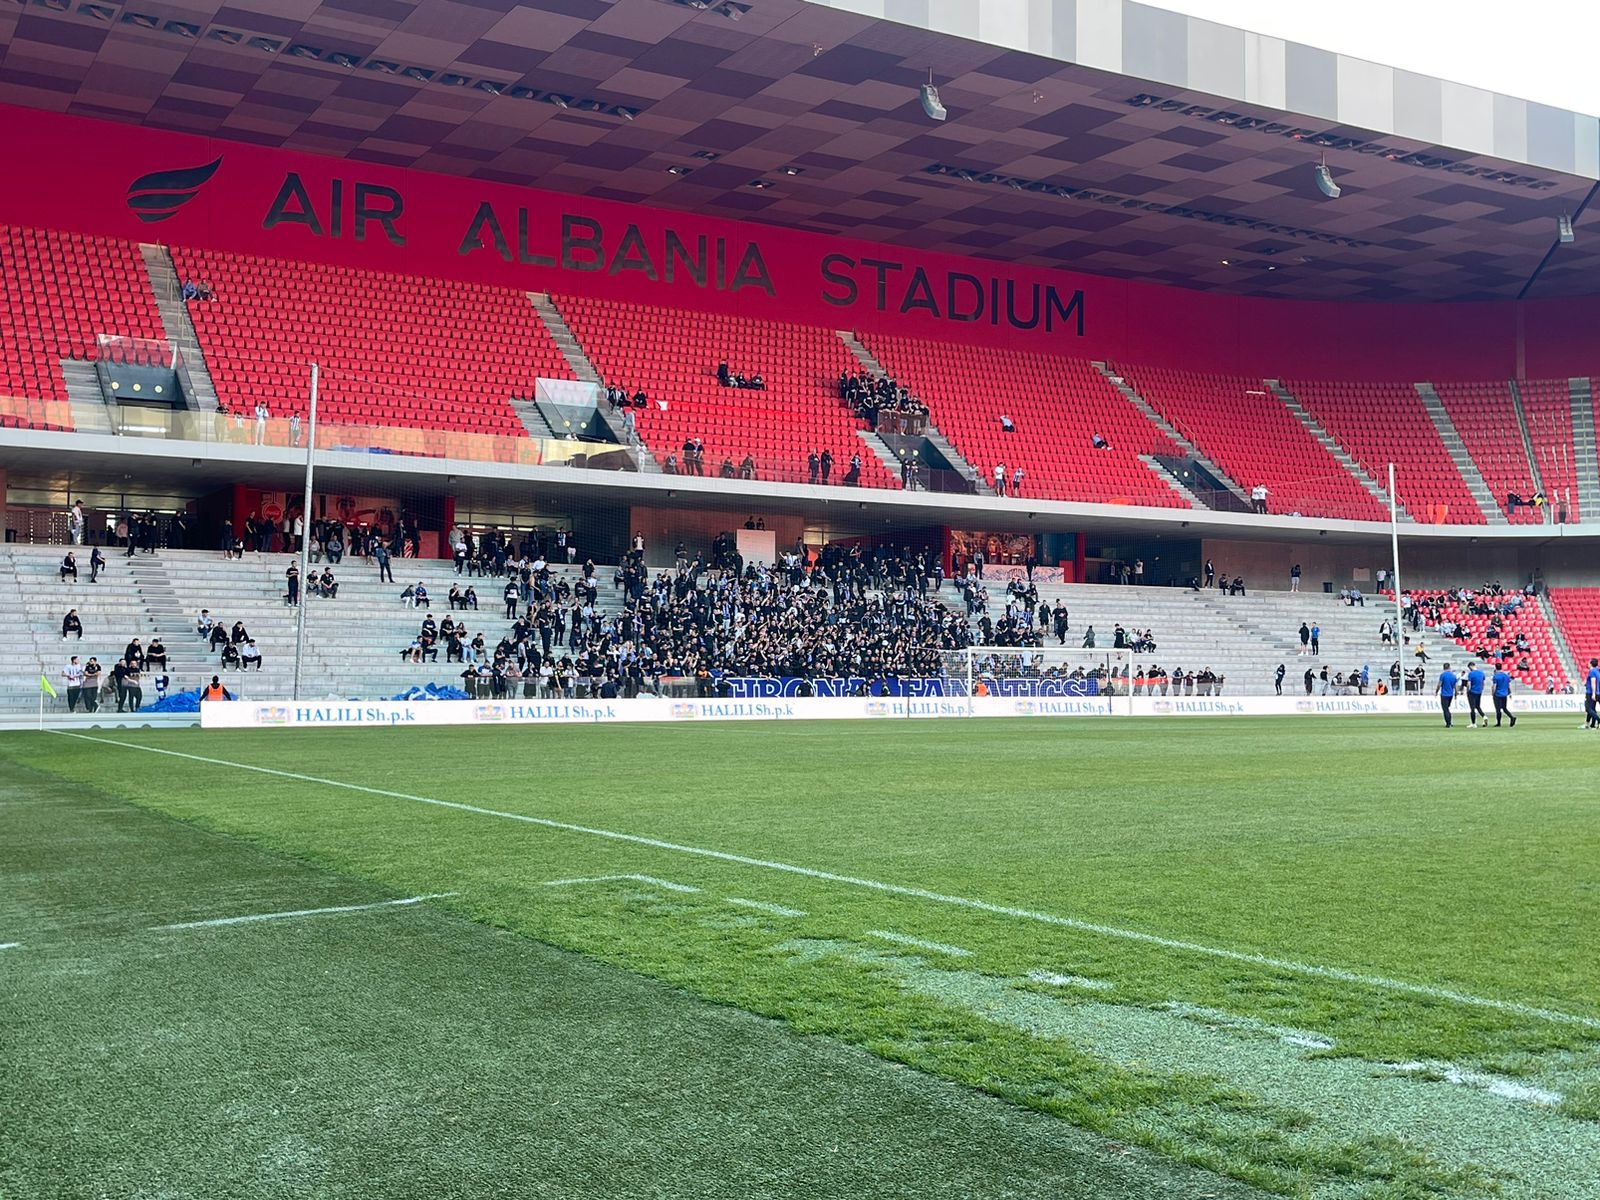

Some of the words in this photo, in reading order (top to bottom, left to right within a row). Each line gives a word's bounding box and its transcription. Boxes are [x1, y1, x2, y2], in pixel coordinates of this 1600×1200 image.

[262, 171, 406, 246] AIR
[457, 201, 777, 297] ALBANIA
[820, 253, 1085, 337] STADIUM
[702, 704, 754, 716] HALILI
[892, 703, 938, 714] HALILI
[1040, 702, 1081, 713] HALILI
[1175, 701, 1213, 712] HALILI
[296, 708, 363, 722] HALILI
[366, 707, 415, 725] Sh.p.k
[511, 706, 569, 719] HALILI
[572, 705, 616, 722] Sh.p.k
